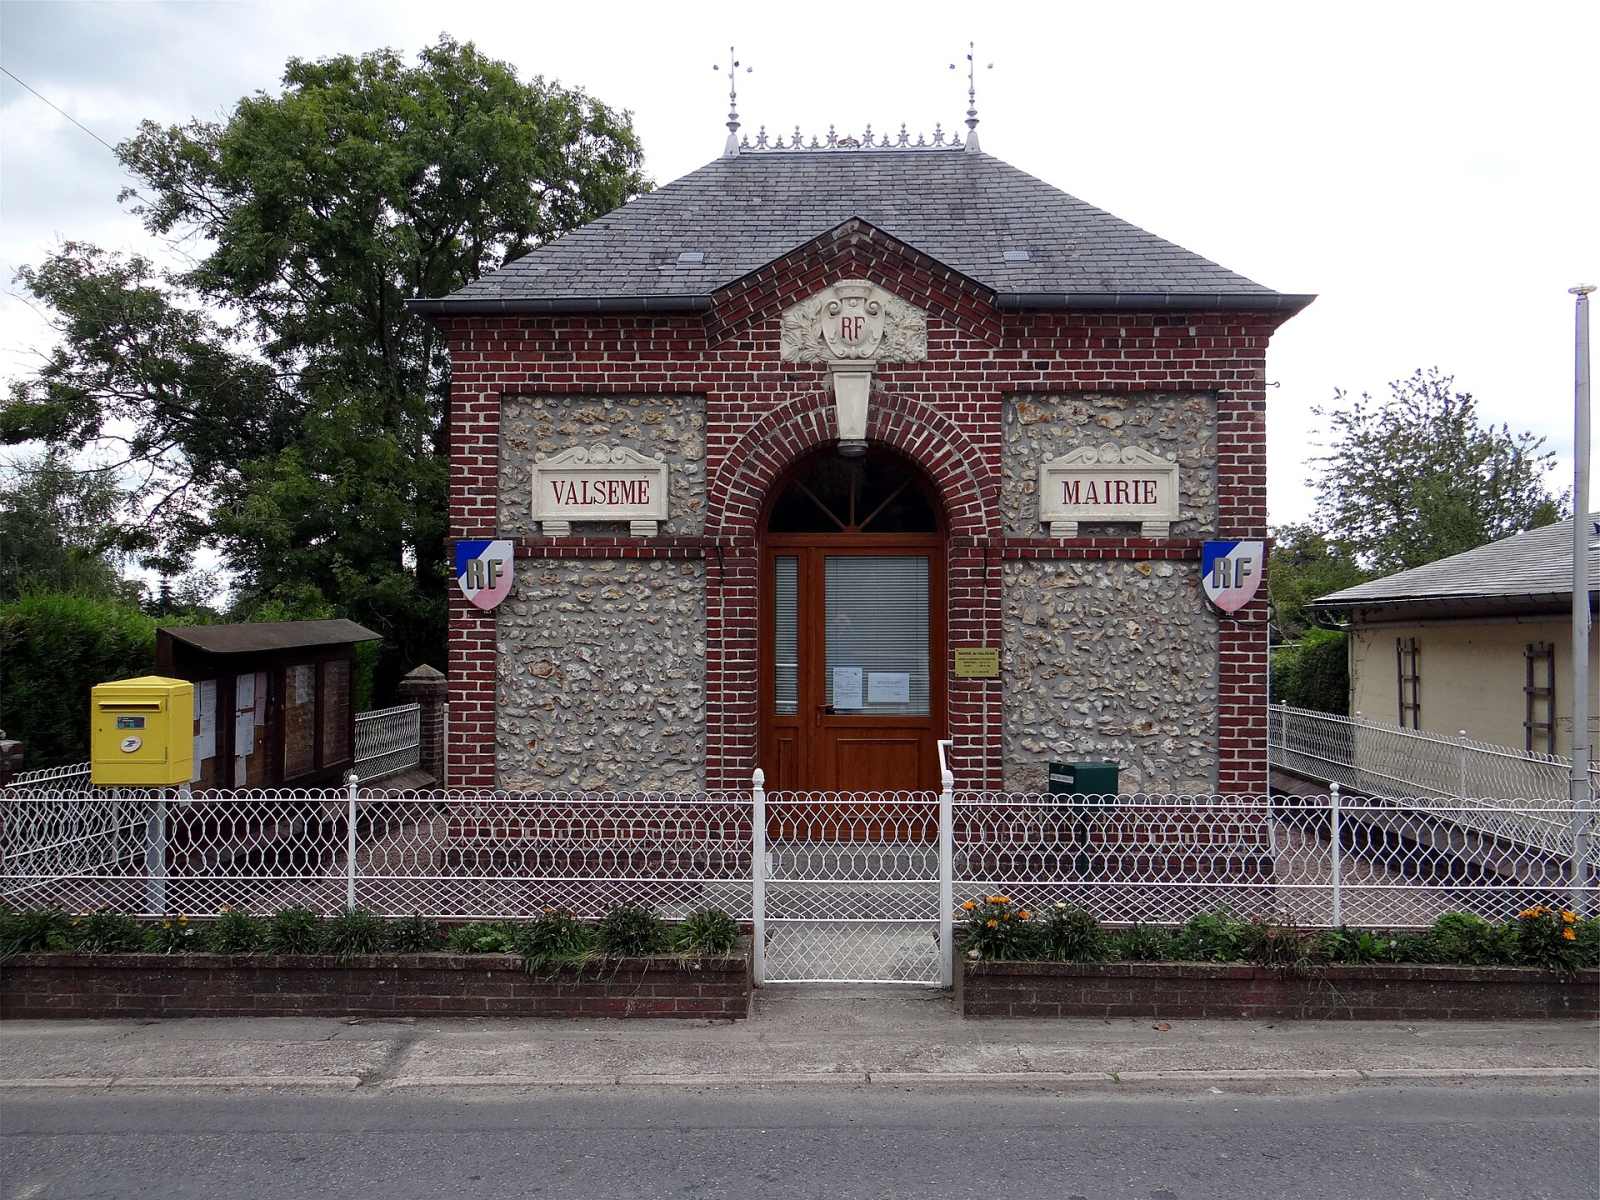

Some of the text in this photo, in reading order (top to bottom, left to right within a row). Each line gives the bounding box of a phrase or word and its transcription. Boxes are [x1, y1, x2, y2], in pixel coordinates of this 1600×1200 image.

[841, 316, 865, 341] RF
[1061, 480, 1156, 505] MAIRIE
[467, 558, 504, 590] RF
[1213, 557, 1252, 589] RF
